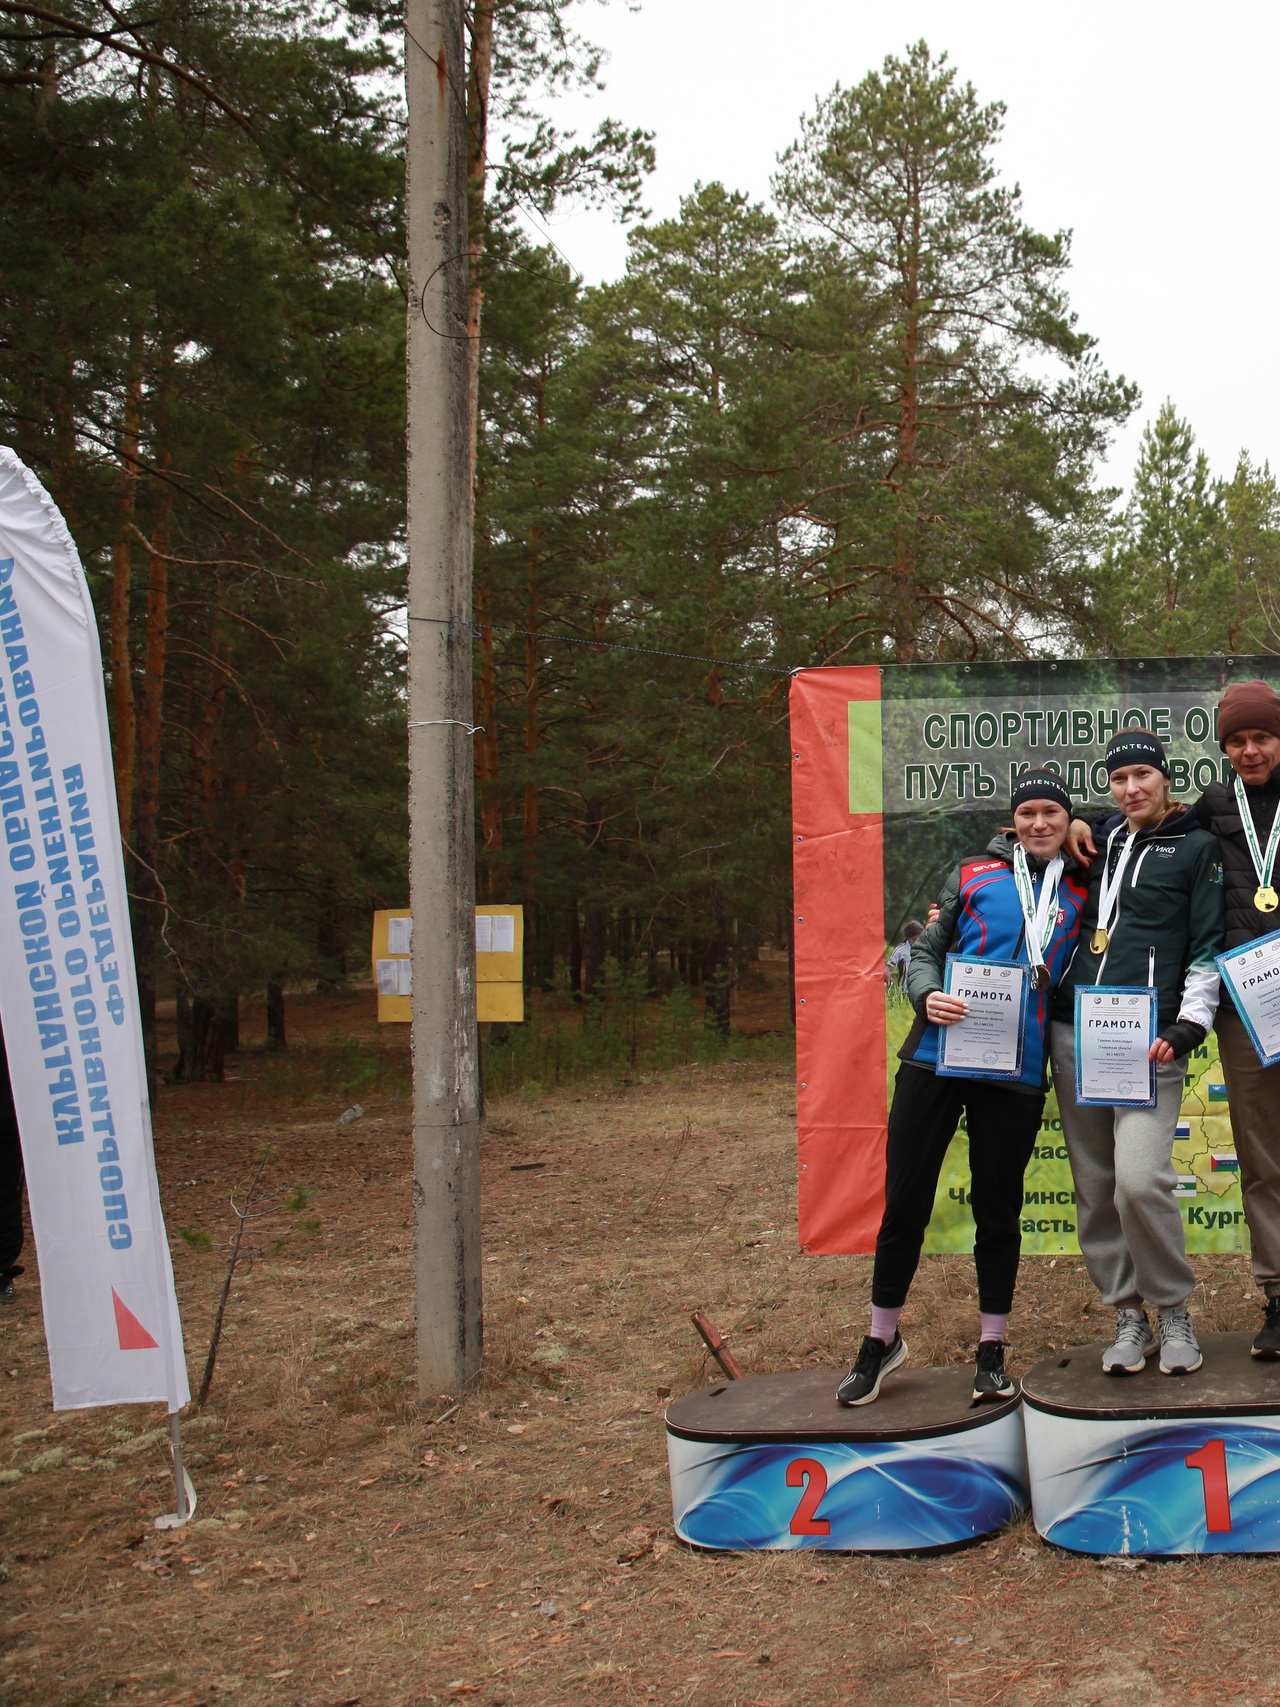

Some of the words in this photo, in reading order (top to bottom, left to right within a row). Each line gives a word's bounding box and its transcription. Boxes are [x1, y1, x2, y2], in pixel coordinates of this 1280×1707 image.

[923, 707, 1172, 749] СПОРТИВНОЕ
[904, 762, 997, 801] ПУТЬ
[957, 988, 1012, 1002] ГРАМОТА
[1088, 1019, 1142, 1029] ГРАМОТА
[785, 1458, 831, 1535] 2
[1185, 1437, 1235, 1533] 1
